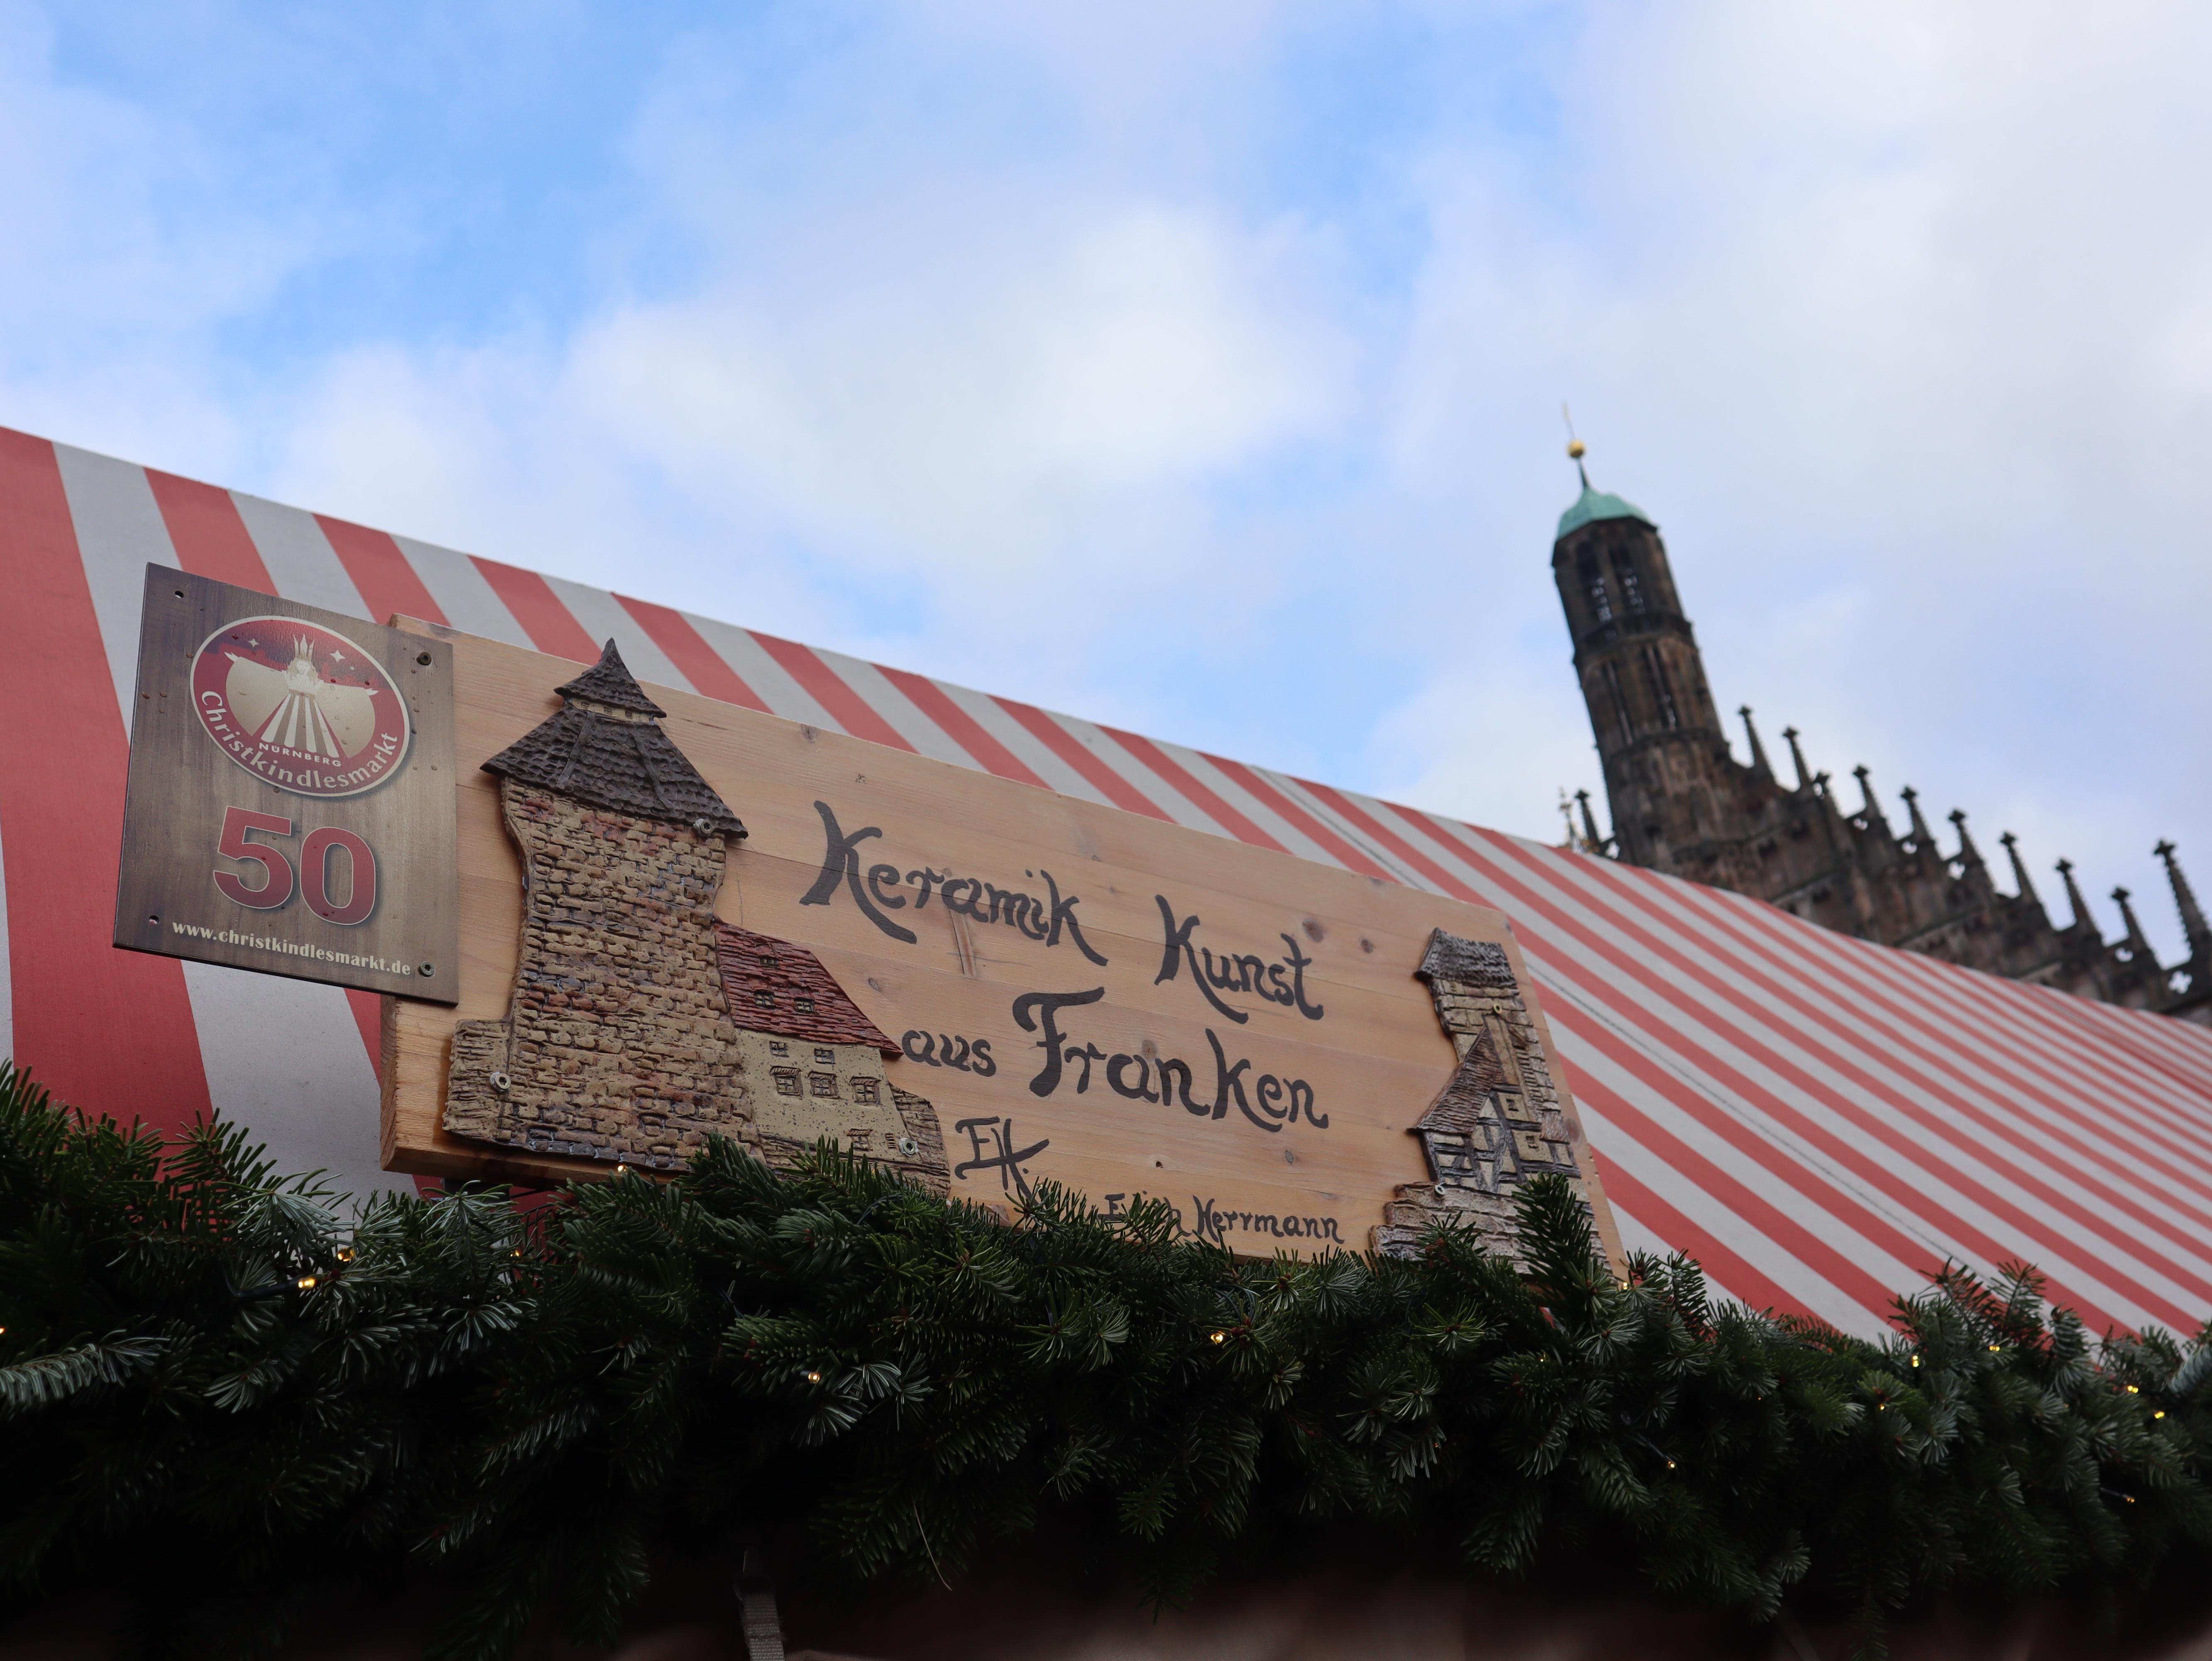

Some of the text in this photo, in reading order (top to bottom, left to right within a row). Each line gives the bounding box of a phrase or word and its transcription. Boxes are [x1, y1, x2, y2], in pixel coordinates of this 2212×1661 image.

[201, 691, 398, 788] Christkindlesmarkt
[259, 742, 342, 767] NÜRNBERG
[213, 806, 376, 926] 50
[799, 800, 1324, 1024] Keramik Kunst
[172, 922, 411, 975] www.christkindlesmarkt.de
[902, 986, 1329, 1132] aus Franken
[1193, 1195, 1345, 1245] Herrmann
